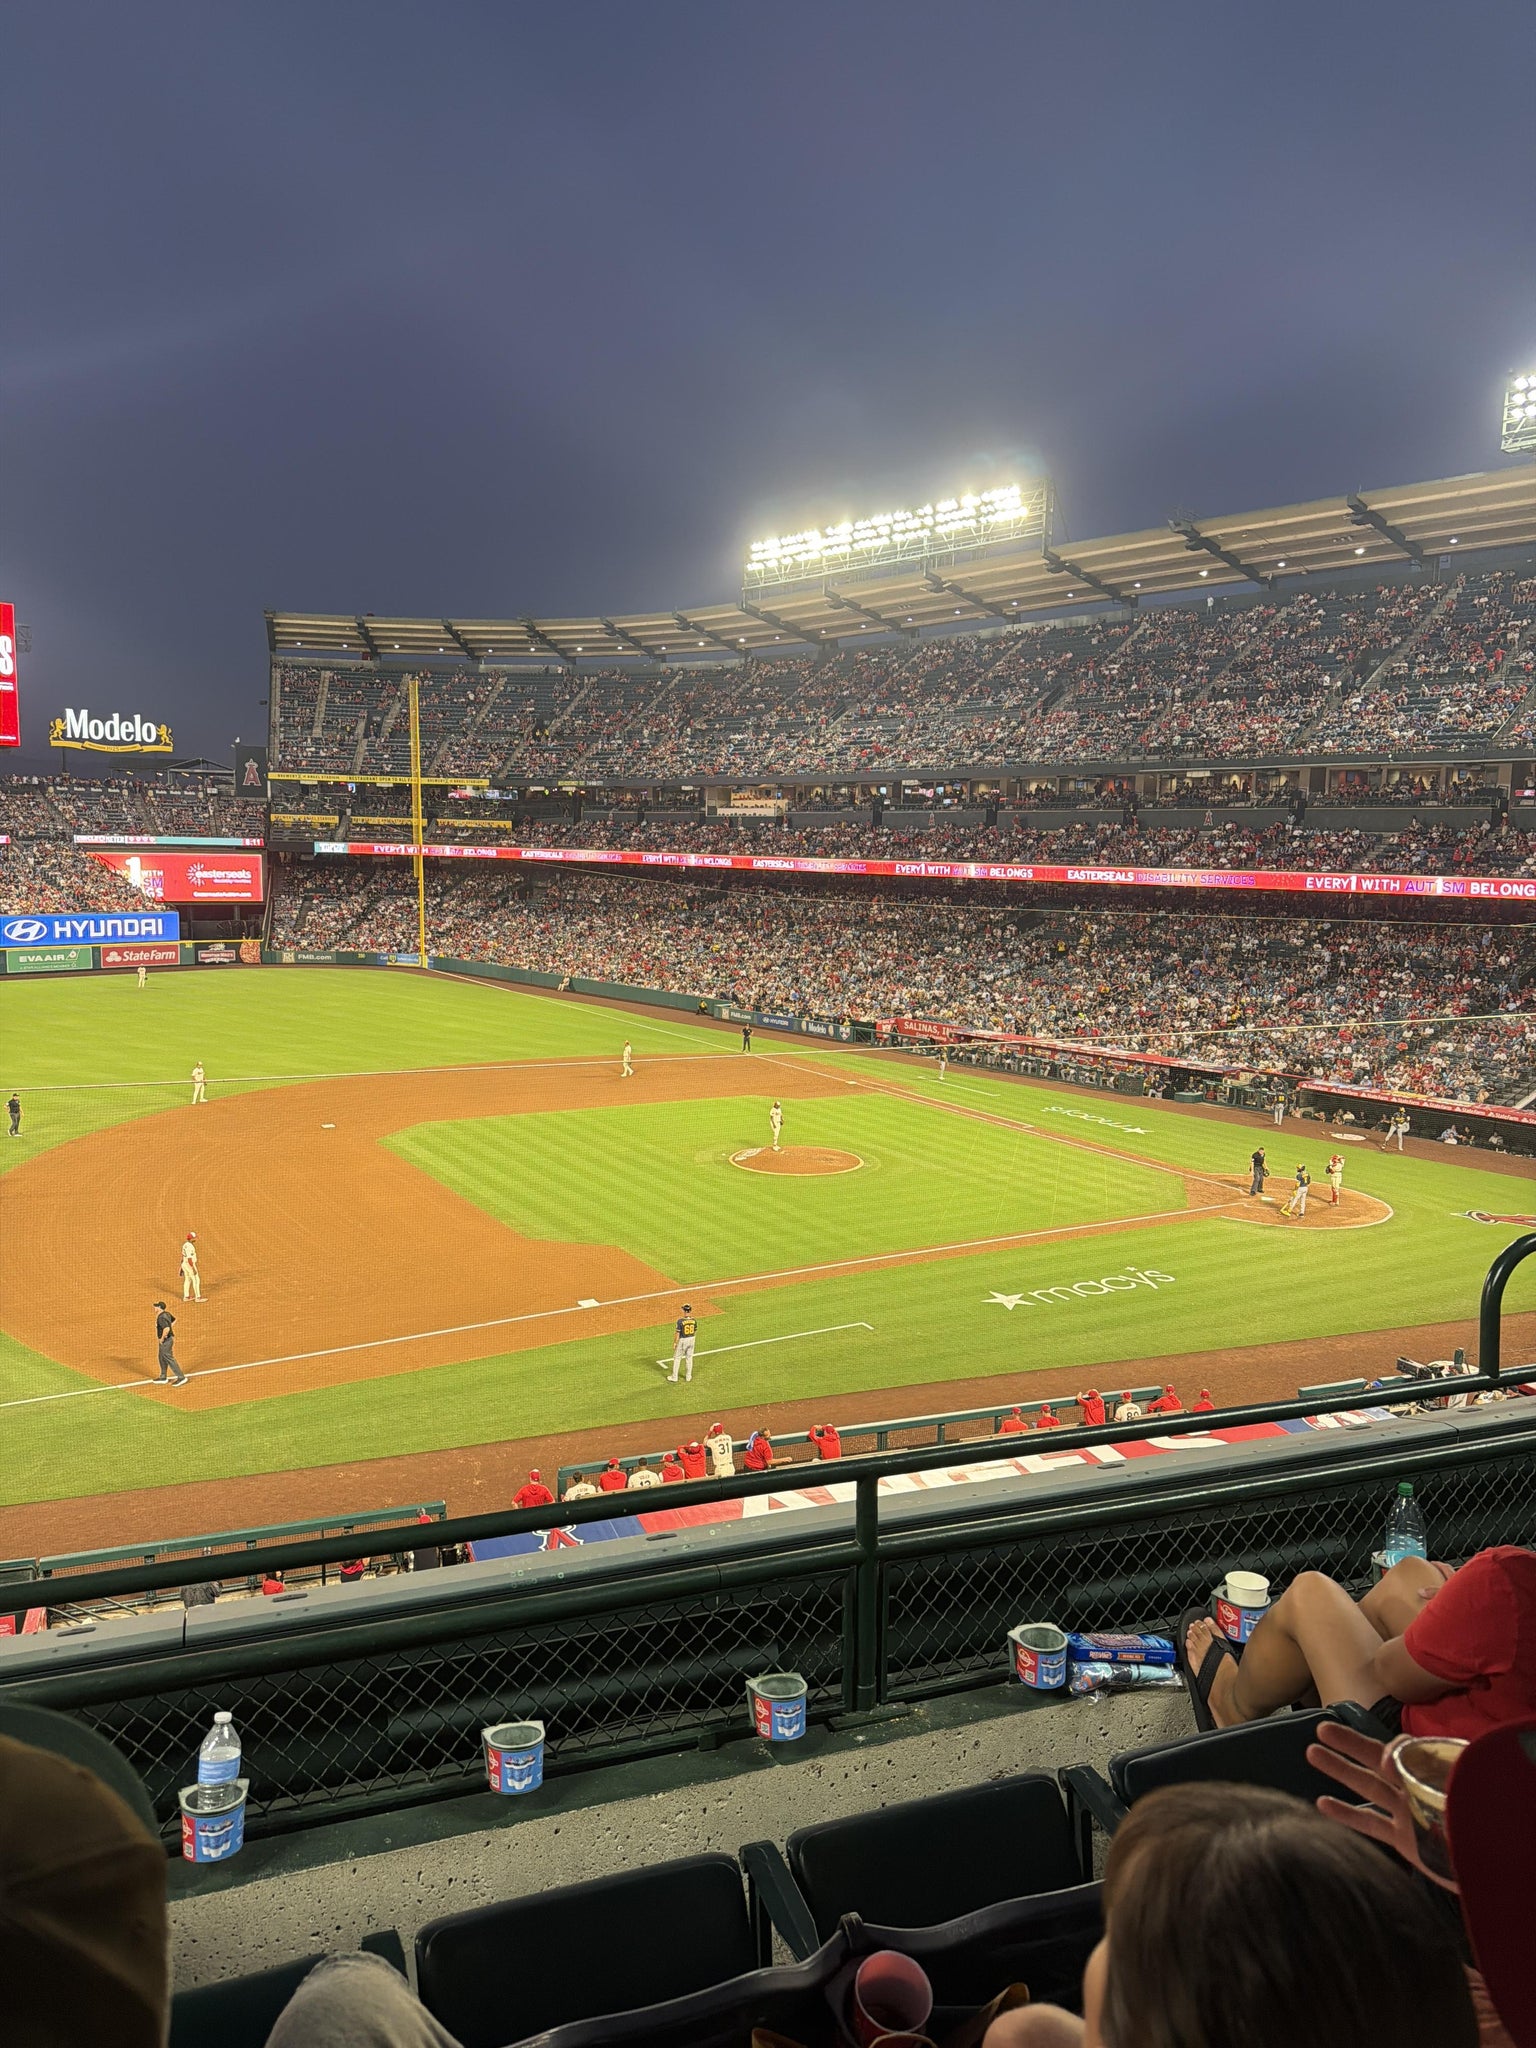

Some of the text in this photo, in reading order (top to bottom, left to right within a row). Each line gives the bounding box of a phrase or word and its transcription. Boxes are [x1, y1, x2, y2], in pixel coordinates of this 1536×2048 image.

[65, 708, 157, 743] Modelo
[406, 847, 429, 855] WIH
[752, 859, 794, 869] EASTERSEALS
[195, 869, 252, 879] easterseals
[927, 865, 951, 875] WITH
[990, 867, 1033, 878] BELONGS
[1067, 869, 1255, 886] EASTERSEALS DISABILITY SERVICES
[1361, 877, 1400, 892] WITH
[54, 918, 163, 939] HYUNDAI
[769, 1018, 789, 1027] HYUNDAI
[808, 1022, 827, 1035] Modelo
[904, 1021, 940, 1035] SALINAS,
[683, 1324, 695, 1335] 68
[718, 1443, 730, 1455] 31
